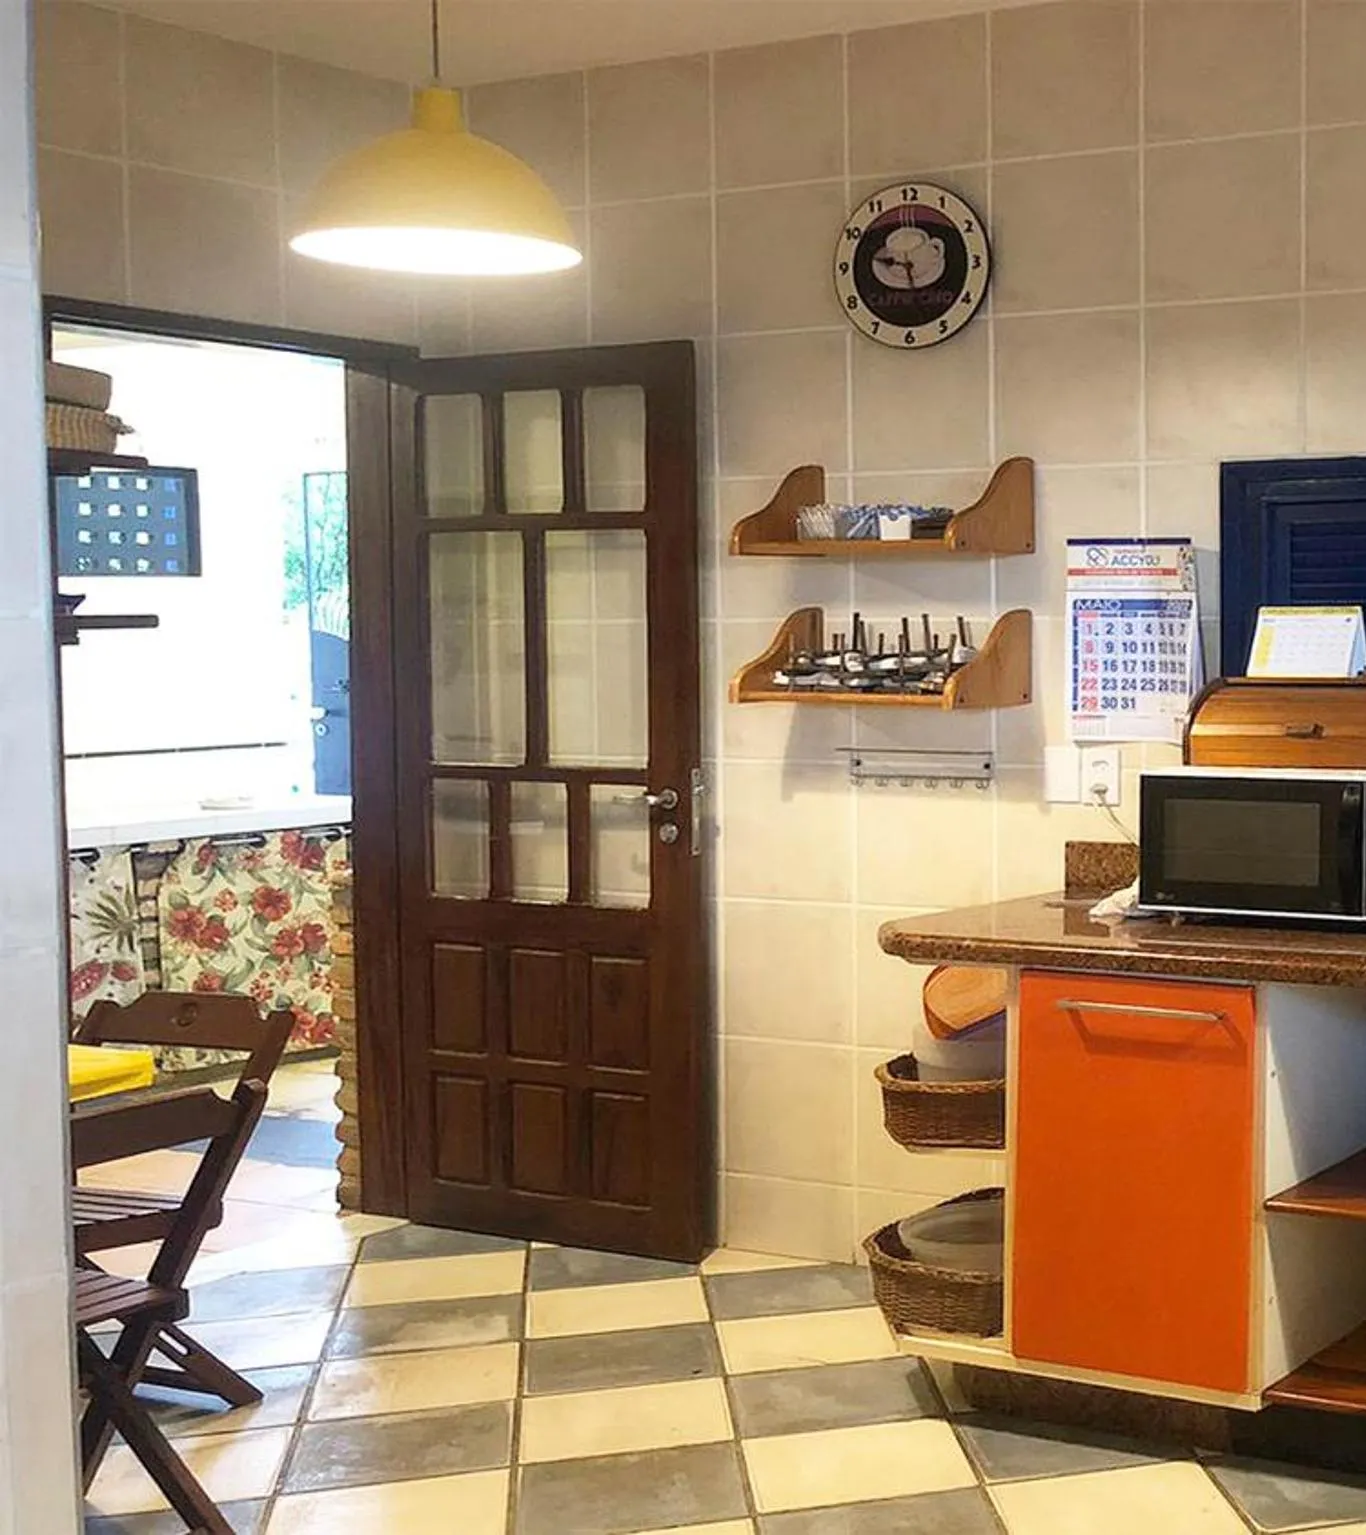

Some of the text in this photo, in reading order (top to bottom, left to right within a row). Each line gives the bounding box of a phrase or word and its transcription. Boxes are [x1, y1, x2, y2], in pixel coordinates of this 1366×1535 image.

[901, 187, 918, 201] 12
[868, 200, 882, 213] 11
[939, 196, 946, 208] 1
[846, 226, 861, 240] 10
[964, 219, 974, 233] 2
[839, 261, 849, 276] 9
[971, 254, 981, 269] 3
[847, 295, 858, 309] 8
[961, 291, 972, 305] 4
[871, 321, 880, 335] 7
[939, 320, 948, 333] 5
[904, 331, 915, 344] 6
[1076, 599, 1121, 610] MAIO
[1105, 622, 1115, 635] 2
[1124, 622, 1134, 635] 3
[1145, 623, 1152, 635] 4
[1105, 640, 1115, 654] 9
[1122, 640, 1138, 654] 10
[1142, 642, 1155, 654] 11
[1081, 659, 1098, 672] 15
[1102, 659, 1118, 672] 16
[1122, 659, 1138, 673] 17
[1142, 660, 1155, 672] 18
[1081, 678, 1098, 691] 22
[1101, 678, 1118, 691] 23
[1121, 678, 1137, 691] 24
[1140, 678, 1156, 691] 25
[1101, 696, 1118, 709] 30
[1120, 696, 1136, 709] 31
